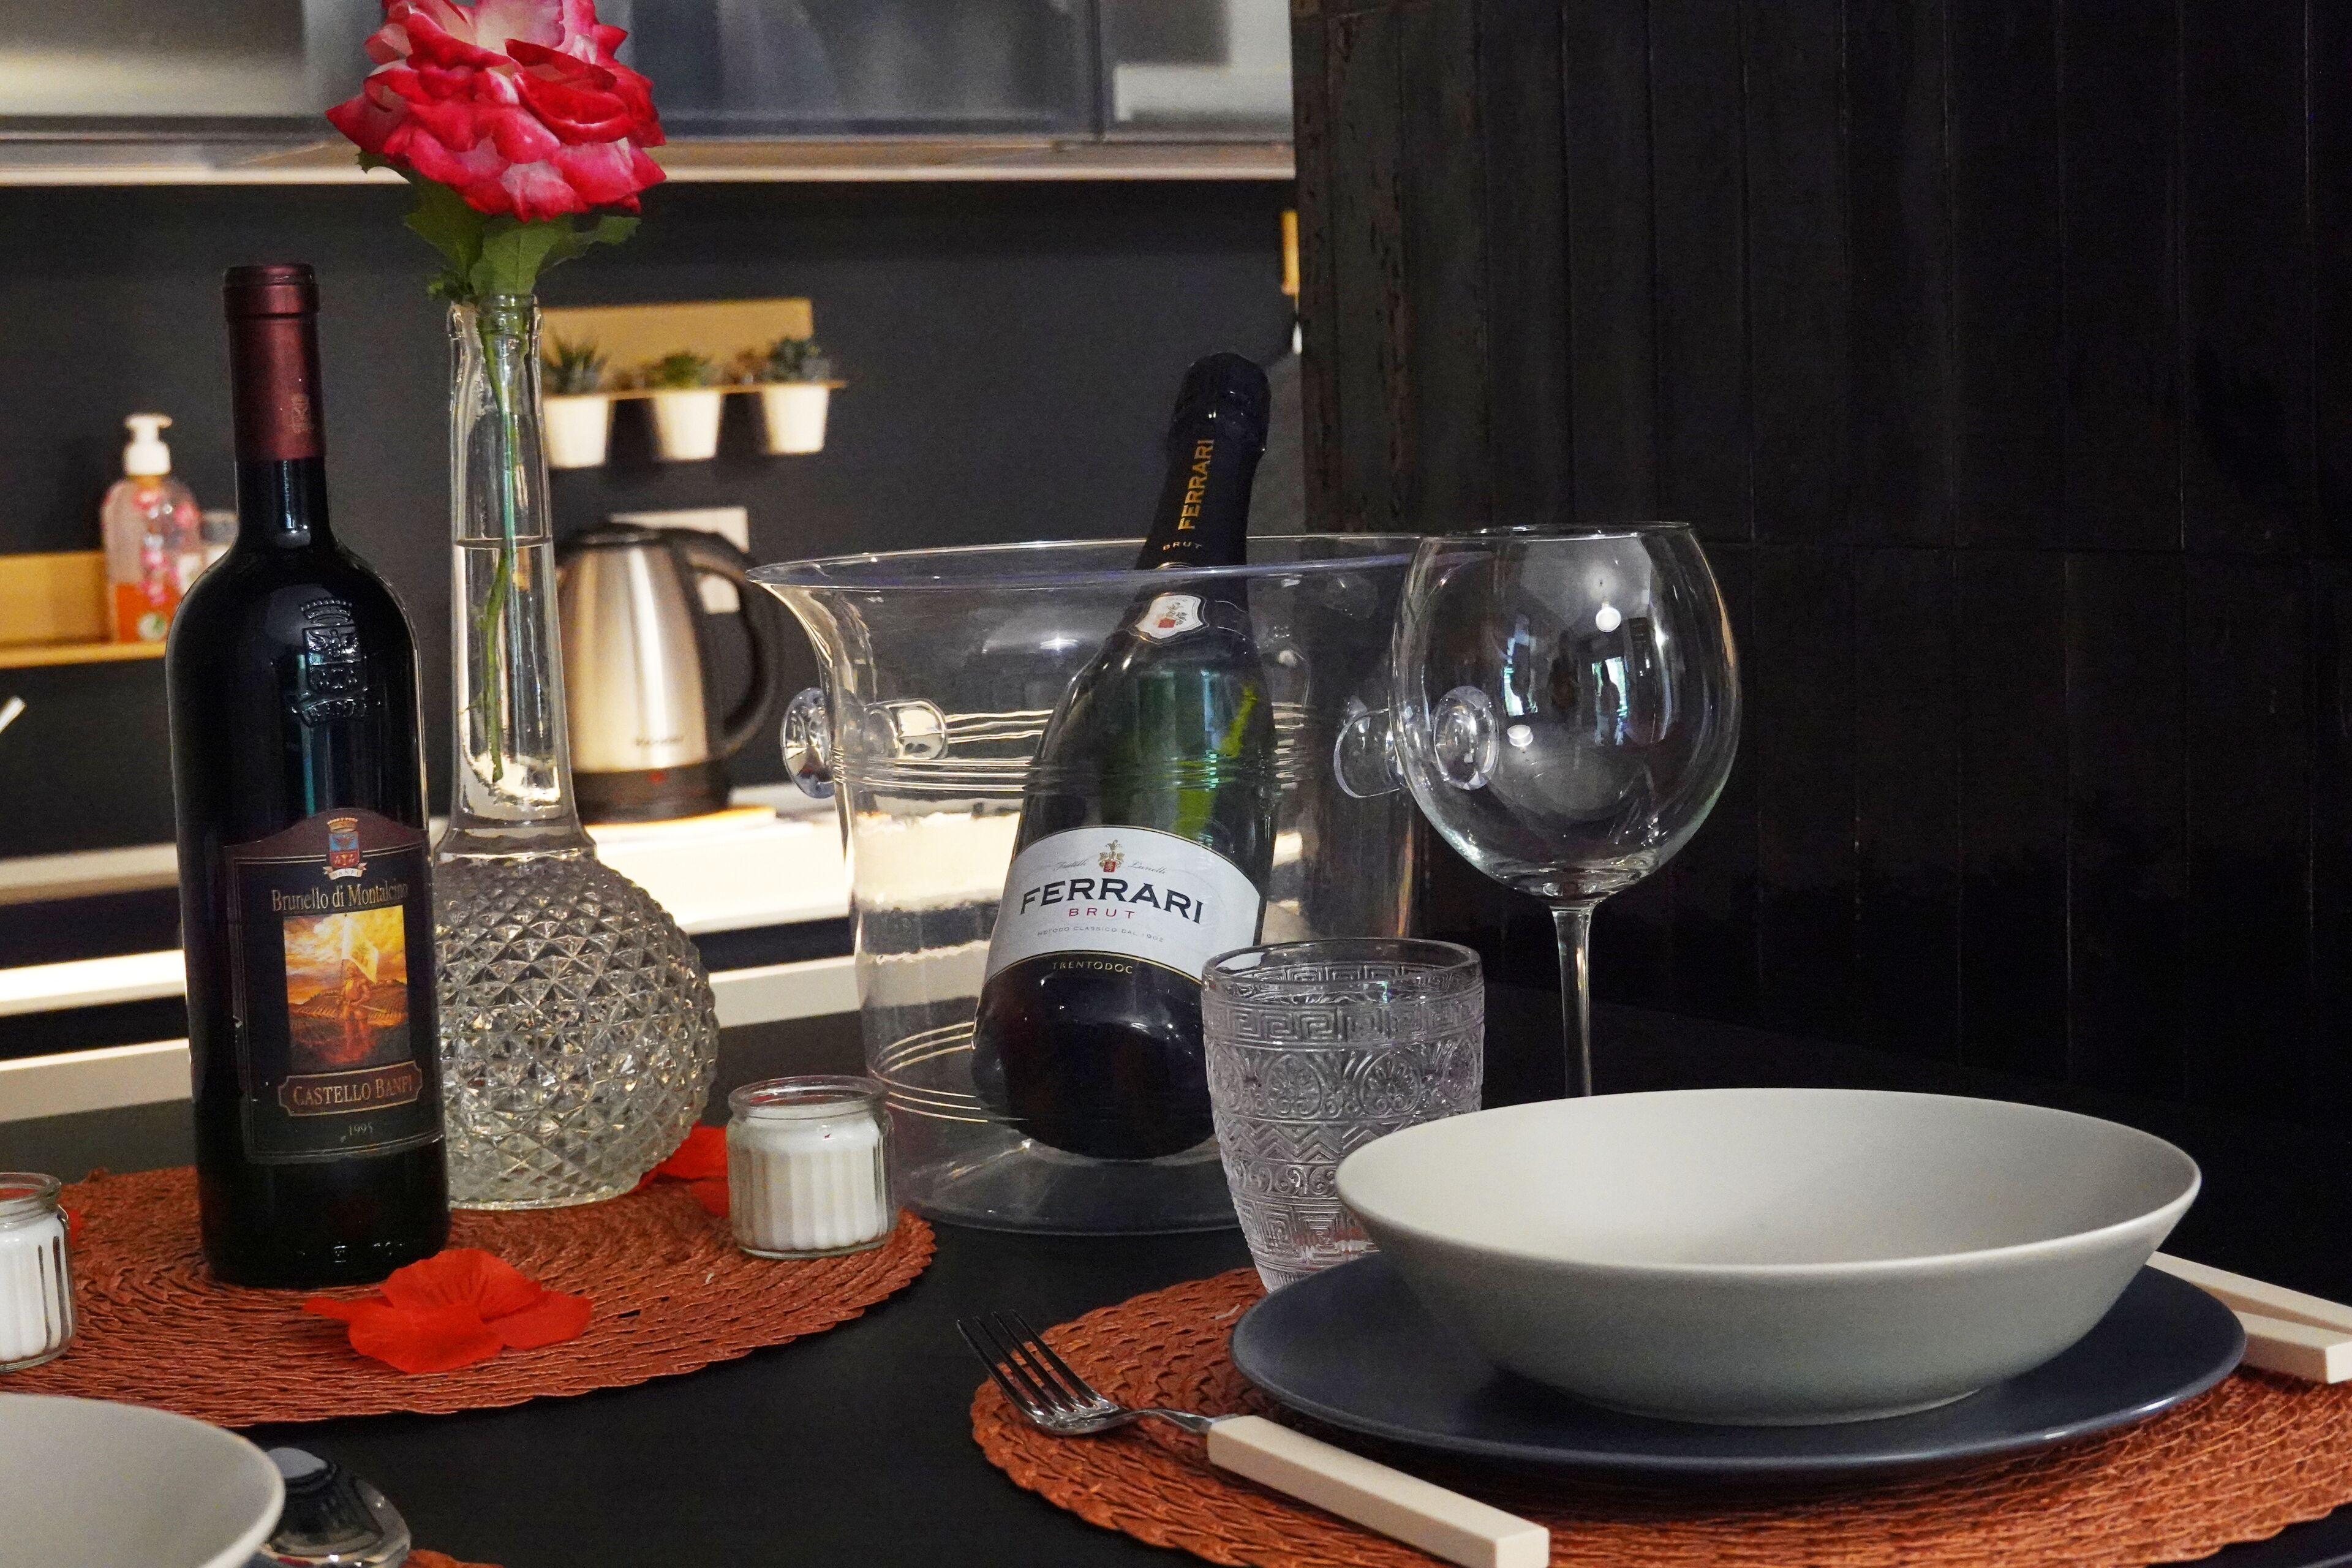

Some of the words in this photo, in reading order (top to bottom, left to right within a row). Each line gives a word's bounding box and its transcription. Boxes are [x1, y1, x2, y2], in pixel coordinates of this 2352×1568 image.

[1178, 439, 1214, 530] FERRARI
[1163, 541, 1202, 551] BRUT
[271, 887, 329, 911] Brunello
[332, 885, 345, 908] di
[347, 878, 409, 907] Montalcino
[1020, 878, 1204, 925] FERRARI
[1068, 907, 1135, 919] BRUT
[1052, 960, 1133, 974] TRENTODOC
[293, 1082, 371, 1105] CASTELLO
